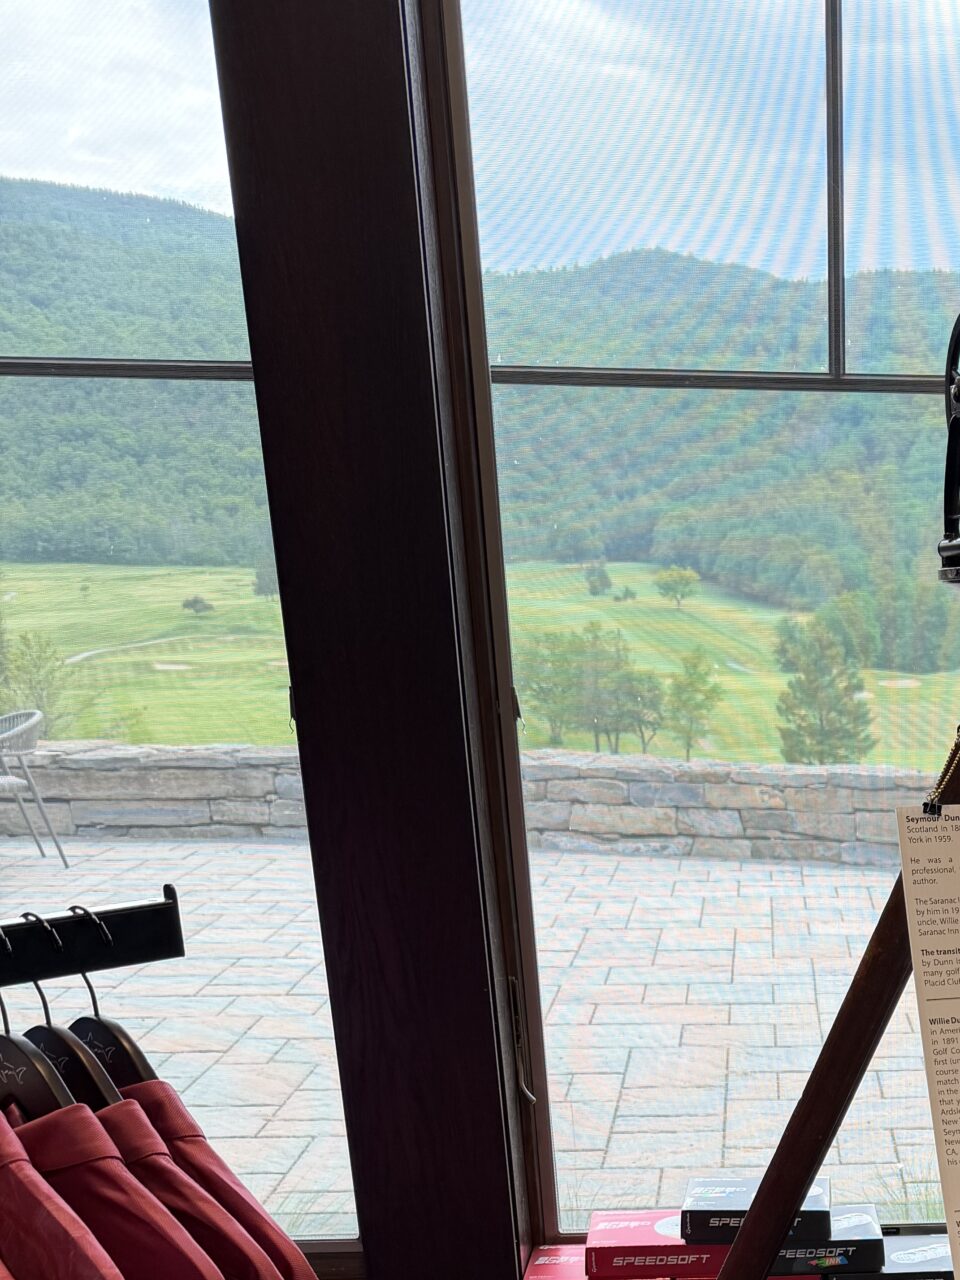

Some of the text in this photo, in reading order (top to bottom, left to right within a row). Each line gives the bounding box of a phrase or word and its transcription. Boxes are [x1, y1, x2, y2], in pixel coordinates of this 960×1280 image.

[906, 813, 940, 824] Seymour
[906, 824, 939, 834] Scotland
[907, 836, 924, 844] York
[934, 835, 953, 843] 1959.
[910, 857, 921, 865] He
[912, 877, 938, 885] author.
[914, 898, 929, 906] The
[928, 897, 957, 905] Saranac
[939, 917, 959, 925] Willie
[918, 928, 946, 937] Saranac
[920, 949, 935, 957] The
[935, 947, 960, 956] transit
[923, 970, 944, 978] many
[945, 967, 960, 978] golf
[924, 978, 946, 987] Placid
[933, 1058, 948, 1066] first
[939, 1098, 954, 1106] that
[778, 1248, 856, 1258] PEEDSOFT
[612, 1255, 711, 1266] SPEEDSOFT
[825, 1256, 842, 1265] INK
